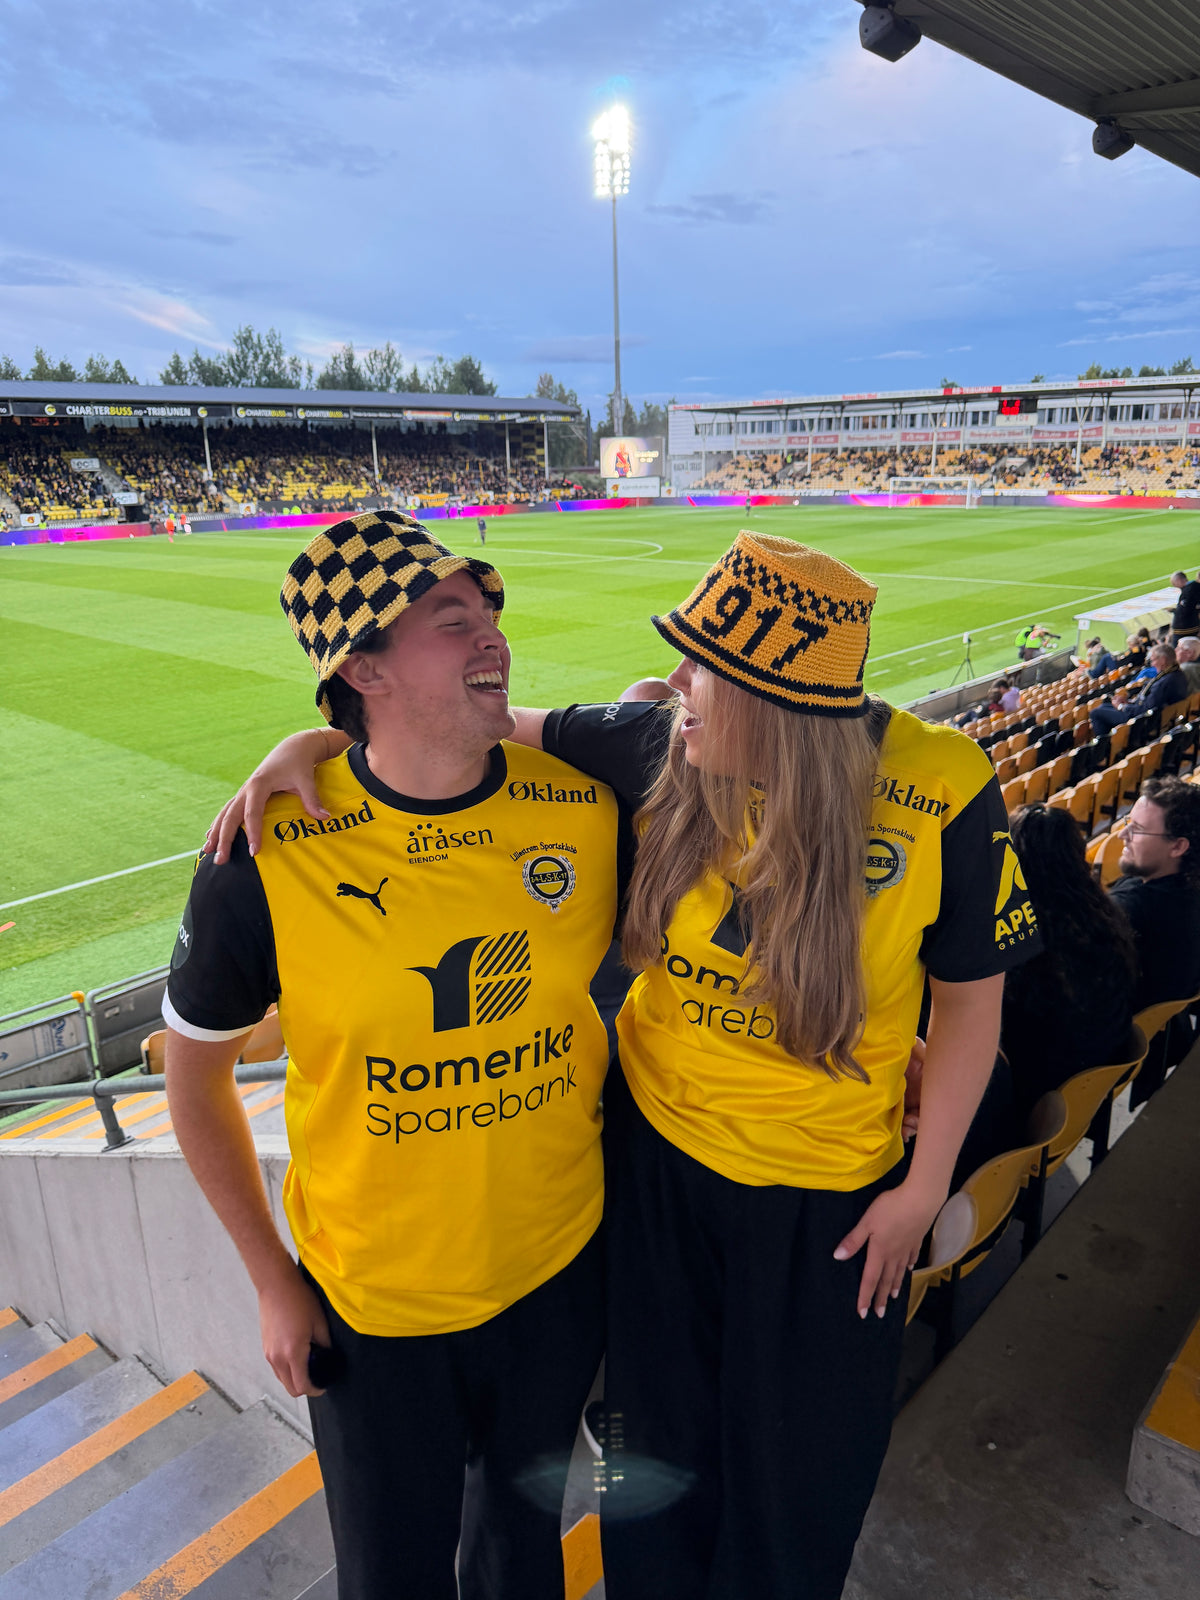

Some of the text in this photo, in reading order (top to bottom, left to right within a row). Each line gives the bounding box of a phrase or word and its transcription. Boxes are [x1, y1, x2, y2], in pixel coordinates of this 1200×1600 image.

[685, 570, 829, 673] 1917
[508, 781, 599, 805] Økland
[273, 800, 376, 846] Økland
[408, 853, 449, 865] EIENDOM
[994, 900, 1037, 942] APE
[365, 1023, 574, 1094] Romerike
[366, 1062, 577, 1144] Sparebank
